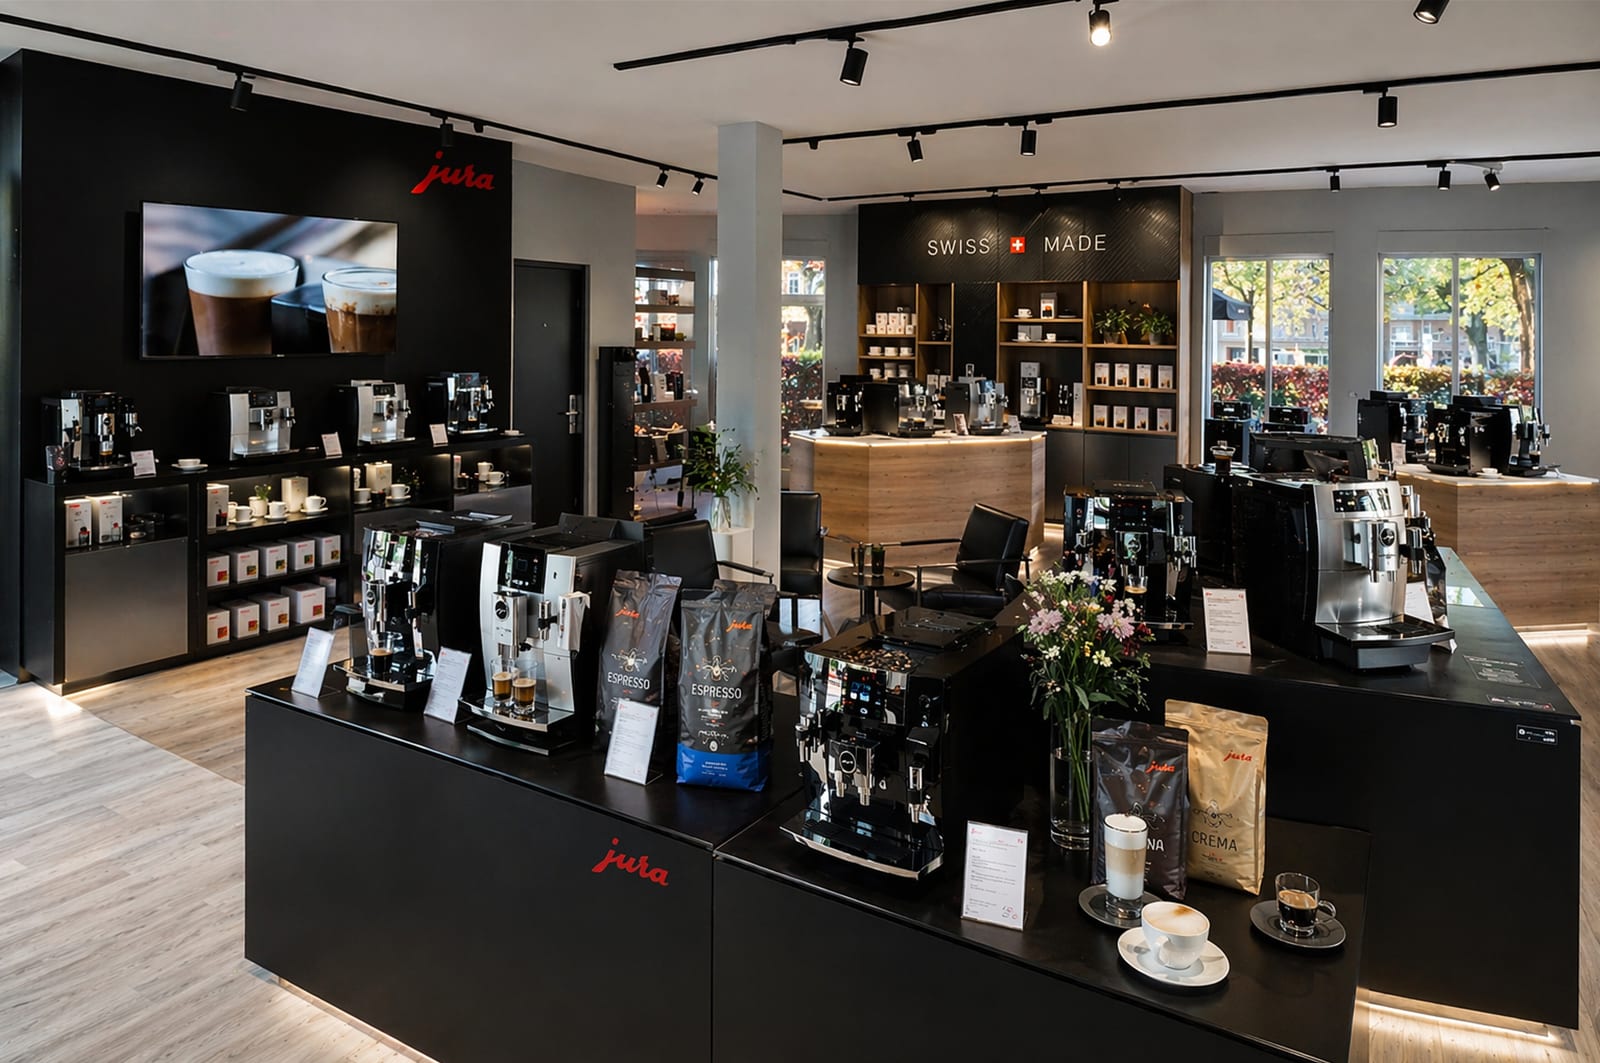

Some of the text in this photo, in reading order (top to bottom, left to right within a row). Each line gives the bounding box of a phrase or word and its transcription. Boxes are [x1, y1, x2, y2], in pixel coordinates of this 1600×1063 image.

[410, 150, 495, 195] jura
[927, 234, 1107, 256] SWISS MADE
[607, 671, 650, 690] ESPRESSO
[691, 683, 742, 700] ESPRESSO
[1191, 830, 1238, 852] CREMA
[591, 837, 669, 887] jura
